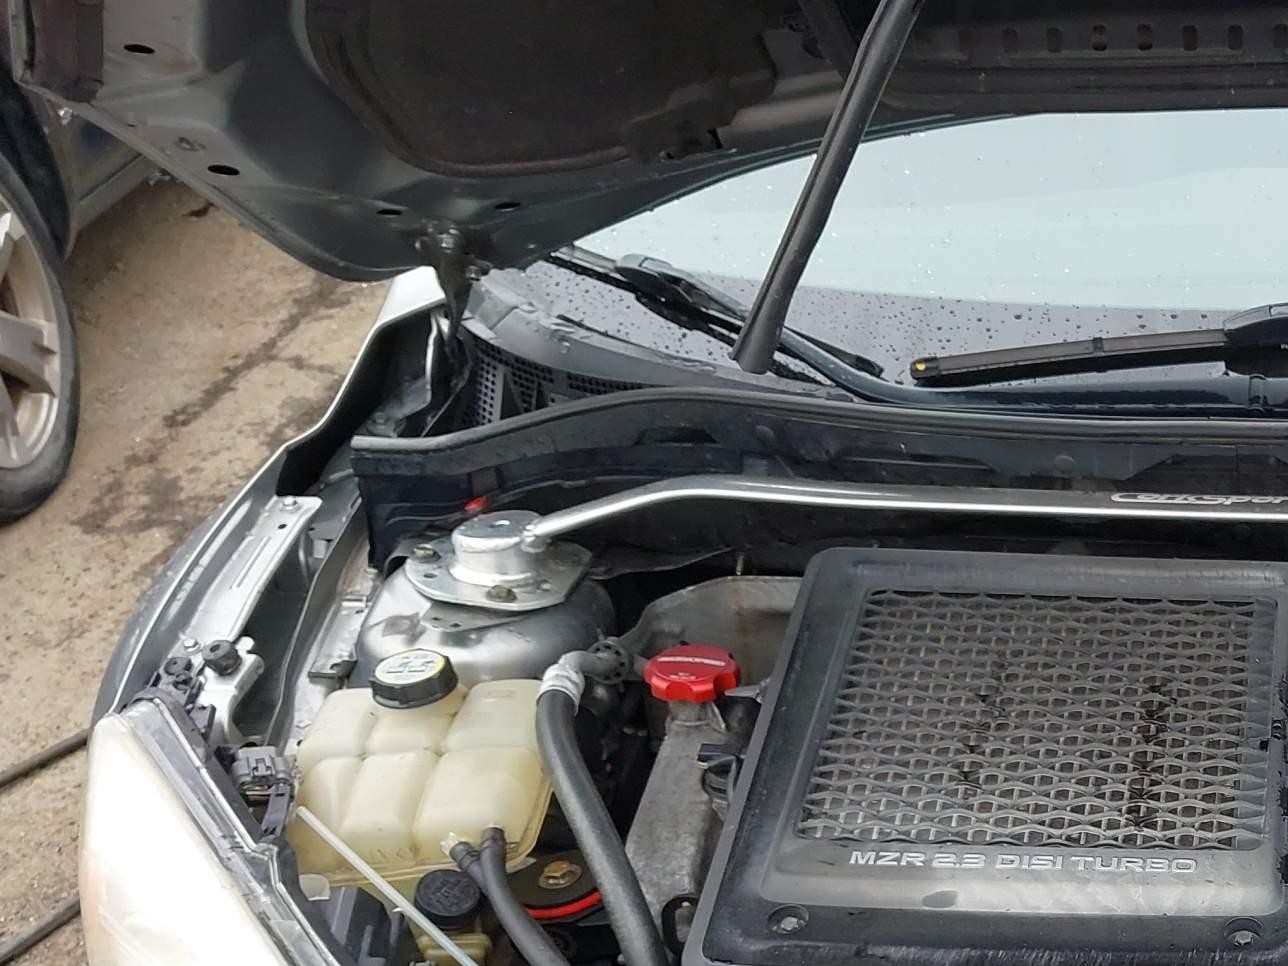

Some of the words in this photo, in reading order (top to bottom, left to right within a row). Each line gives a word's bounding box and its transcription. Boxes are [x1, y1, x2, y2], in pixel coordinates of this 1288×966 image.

[850, 850, 926, 867] MZR
[931, 852, 986, 869] 2.3
[995, 853, 1064, 871] DISI
[1071, 855, 1198, 873] TURBO
